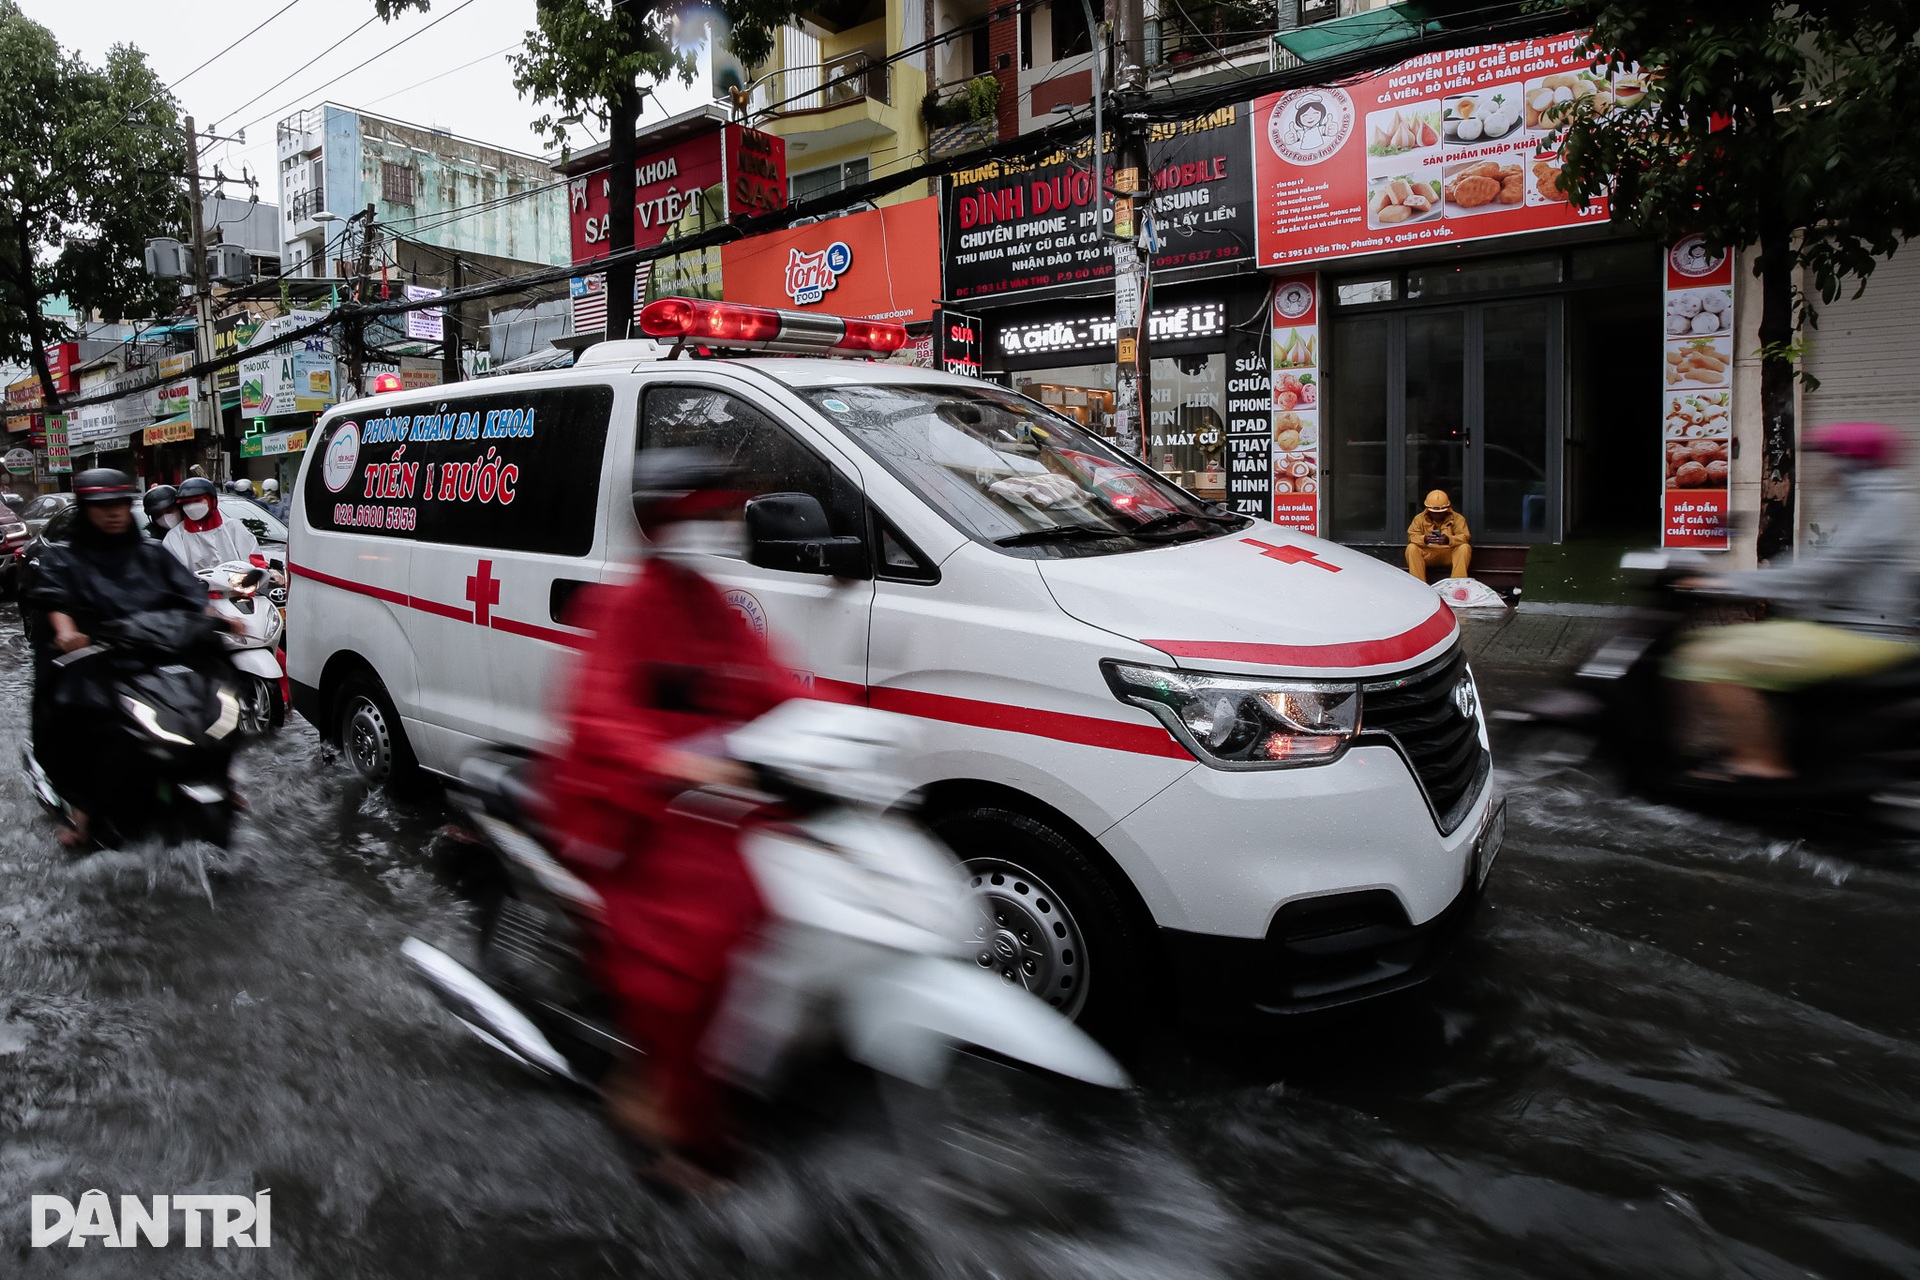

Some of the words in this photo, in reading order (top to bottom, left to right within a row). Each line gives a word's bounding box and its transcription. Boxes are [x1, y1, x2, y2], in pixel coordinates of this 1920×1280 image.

[1389, 67, 1443, 88] NGUYÊN
[1446, 59, 1476, 76] LIỆU
[1479, 47, 1507, 68] CHẾ
[1510, 39, 1545, 62] BIẾN
[1377, 92, 1392, 104] CÁ
[1393, 87, 1423, 100] VIÊN,
[1425, 81, 1441, 94] BÒ
[1444, 76, 1476, 90] VIÊN,
[1477, 69, 1493, 83] GÀ
[1496, 63, 1521, 79] RÁN
[1523, 57, 1559, 73] GIÒN,
[1293, 152, 1318, 161] Foods
[1318, 114, 1350, 157] Ingredients
[1423, 153, 1444, 166] SẢN
[1446, 146, 1478, 163] PHẨM
[1481, 143, 1511, 158] NHẬP
[635, 157, 678, 187] KHOA
[951, 162, 999, 187] TRUNG
[959, 186, 1025, 229] ĐÌNH
[1151, 156, 1228, 191] MOBILE
[636, 186, 702, 229] VIỆT
[585, 217, 610, 244] SA
[956, 254, 977, 266] THU
[980, 248, 1004, 262] MUA
[1007, 243, 1032, 257] MÁY
[1036, 237, 1052, 252] CŨ
[1055, 233, 1076, 248] GIÁ
[1173, 211, 1199, 228] LẤY
[1204, 205, 1237, 223] LIỀN
[961, 225, 1013, 249] CHUYÊN
[1016, 216, 1067, 239] IPHONE
[1288, 249, 1303, 258] 395
[1304, 246, 1313, 256] Lê
[1314, 245, 1330, 253] Văn
[1331, 243, 1350, 252] Thọ,
[1351, 237, 1384, 249] Phường
[1384, 235, 1394, 244] 9,
[1395, 231, 1418, 243] Quận
[1419, 229, 1432, 238] Gò
[1433, 225, 1454, 237] Vấp.
[976, 283, 994, 294] 393
[1188, 250, 1211, 262] 637
[1215, 246, 1240, 258] 392
[1012, 257, 1044, 272] NHẬN
[1047, 251, 1072, 266] ĐÀO
[1075, 247, 1100, 263] TẠO
[797, 290, 821, 302] FOOD
[951, 322, 975, 345] SỬA
[1122, 345, 1131, 354] 31
[1235, 351, 1267, 372] SỬA
[1228, 373, 1270, 393] CHỮA
[1186, 386, 1220, 408] LIỀN
[1229, 398, 1271, 413] IPHONE
[409, 403, 457, 443] KHÁM
[454, 407, 481, 440] ĐA
[482, 407, 535, 439] KHOA
[1231, 419, 1267, 432] IPAD
[1166, 430, 1197, 446] MÁY
[1199, 428, 1219, 444] CŨ
[1229, 439, 1271, 453] THAY
[363, 444, 419, 499] TIẾN
[1232, 455, 1267, 473] MÀN
[1231, 475, 1269, 493] HÌNH
[333, 503, 384, 528] 028.6680
[386, 507, 417, 531] 5353
[1237, 499, 1263, 513] ZIN
[1674, 502, 1695, 512] HẤP
[1696, 502, 1718, 512] DẪN
[1672, 513, 1685, 524] VỀ
[1686, 515, 1704, 524] GIÁ
[1705, 515, 1719, 524] VÀ
[1667, 525, 1692, 536] CHẤT
[1693, 528, 1724, 538] LƯỢNG
